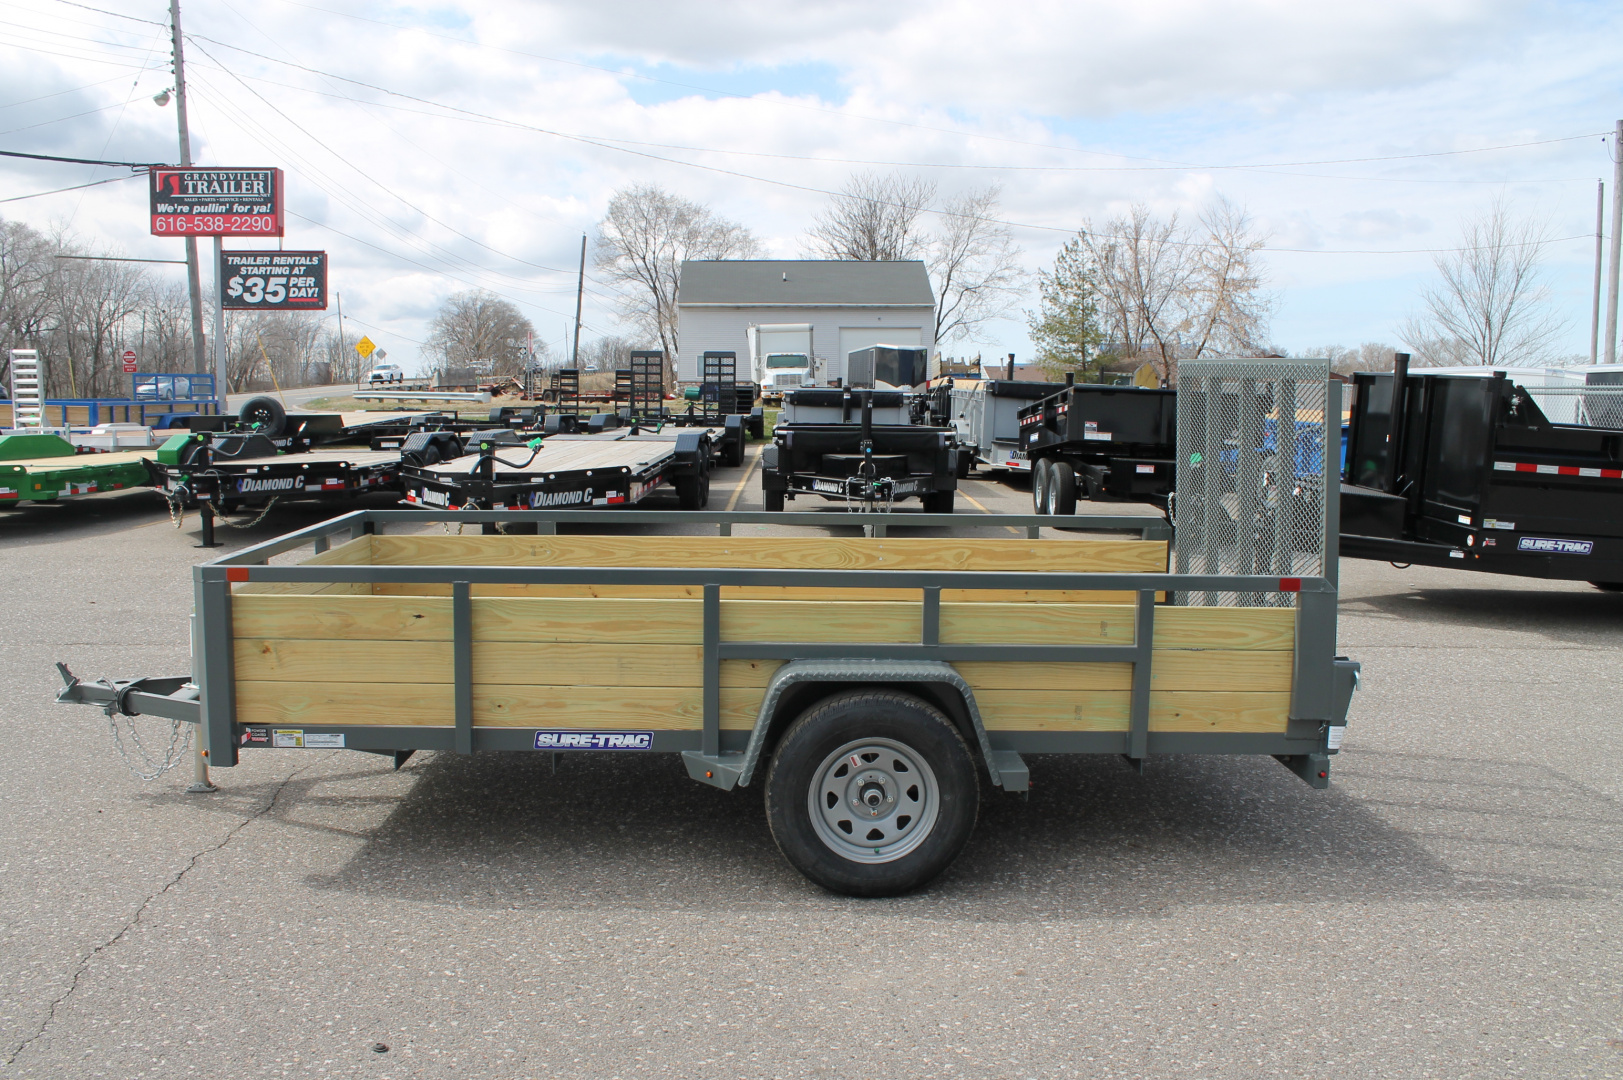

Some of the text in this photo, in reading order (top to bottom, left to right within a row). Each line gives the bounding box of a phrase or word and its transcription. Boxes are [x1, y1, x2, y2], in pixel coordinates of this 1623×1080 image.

[184, 173, 265, 181] GRANDVILLE
[184, 180, 265, 194] TRAILER
[156, 203, 271, 215] We're pullin' for ya!
[156, 216, 272, 232] 616-538-2290
[227, 256, 319, 265] TRAILER RENTALS
[239, 266, 306, 275] STARTING AT
[288, 277, 316, 287] PER
[227, 275, 288, 304] $35
[288, 287, 319, 298] DAY!
[242, 475, 305, 492] DIAMOND C
[814, 479, 839, 492] DIAMOND
[534, 490, 583, 507] DIAMOND
[584, 487, 593, 503] C
[1519, 539, 1591, 553] SURE-TRAC
[537, 733, 650, 748] SURE-TRAC
